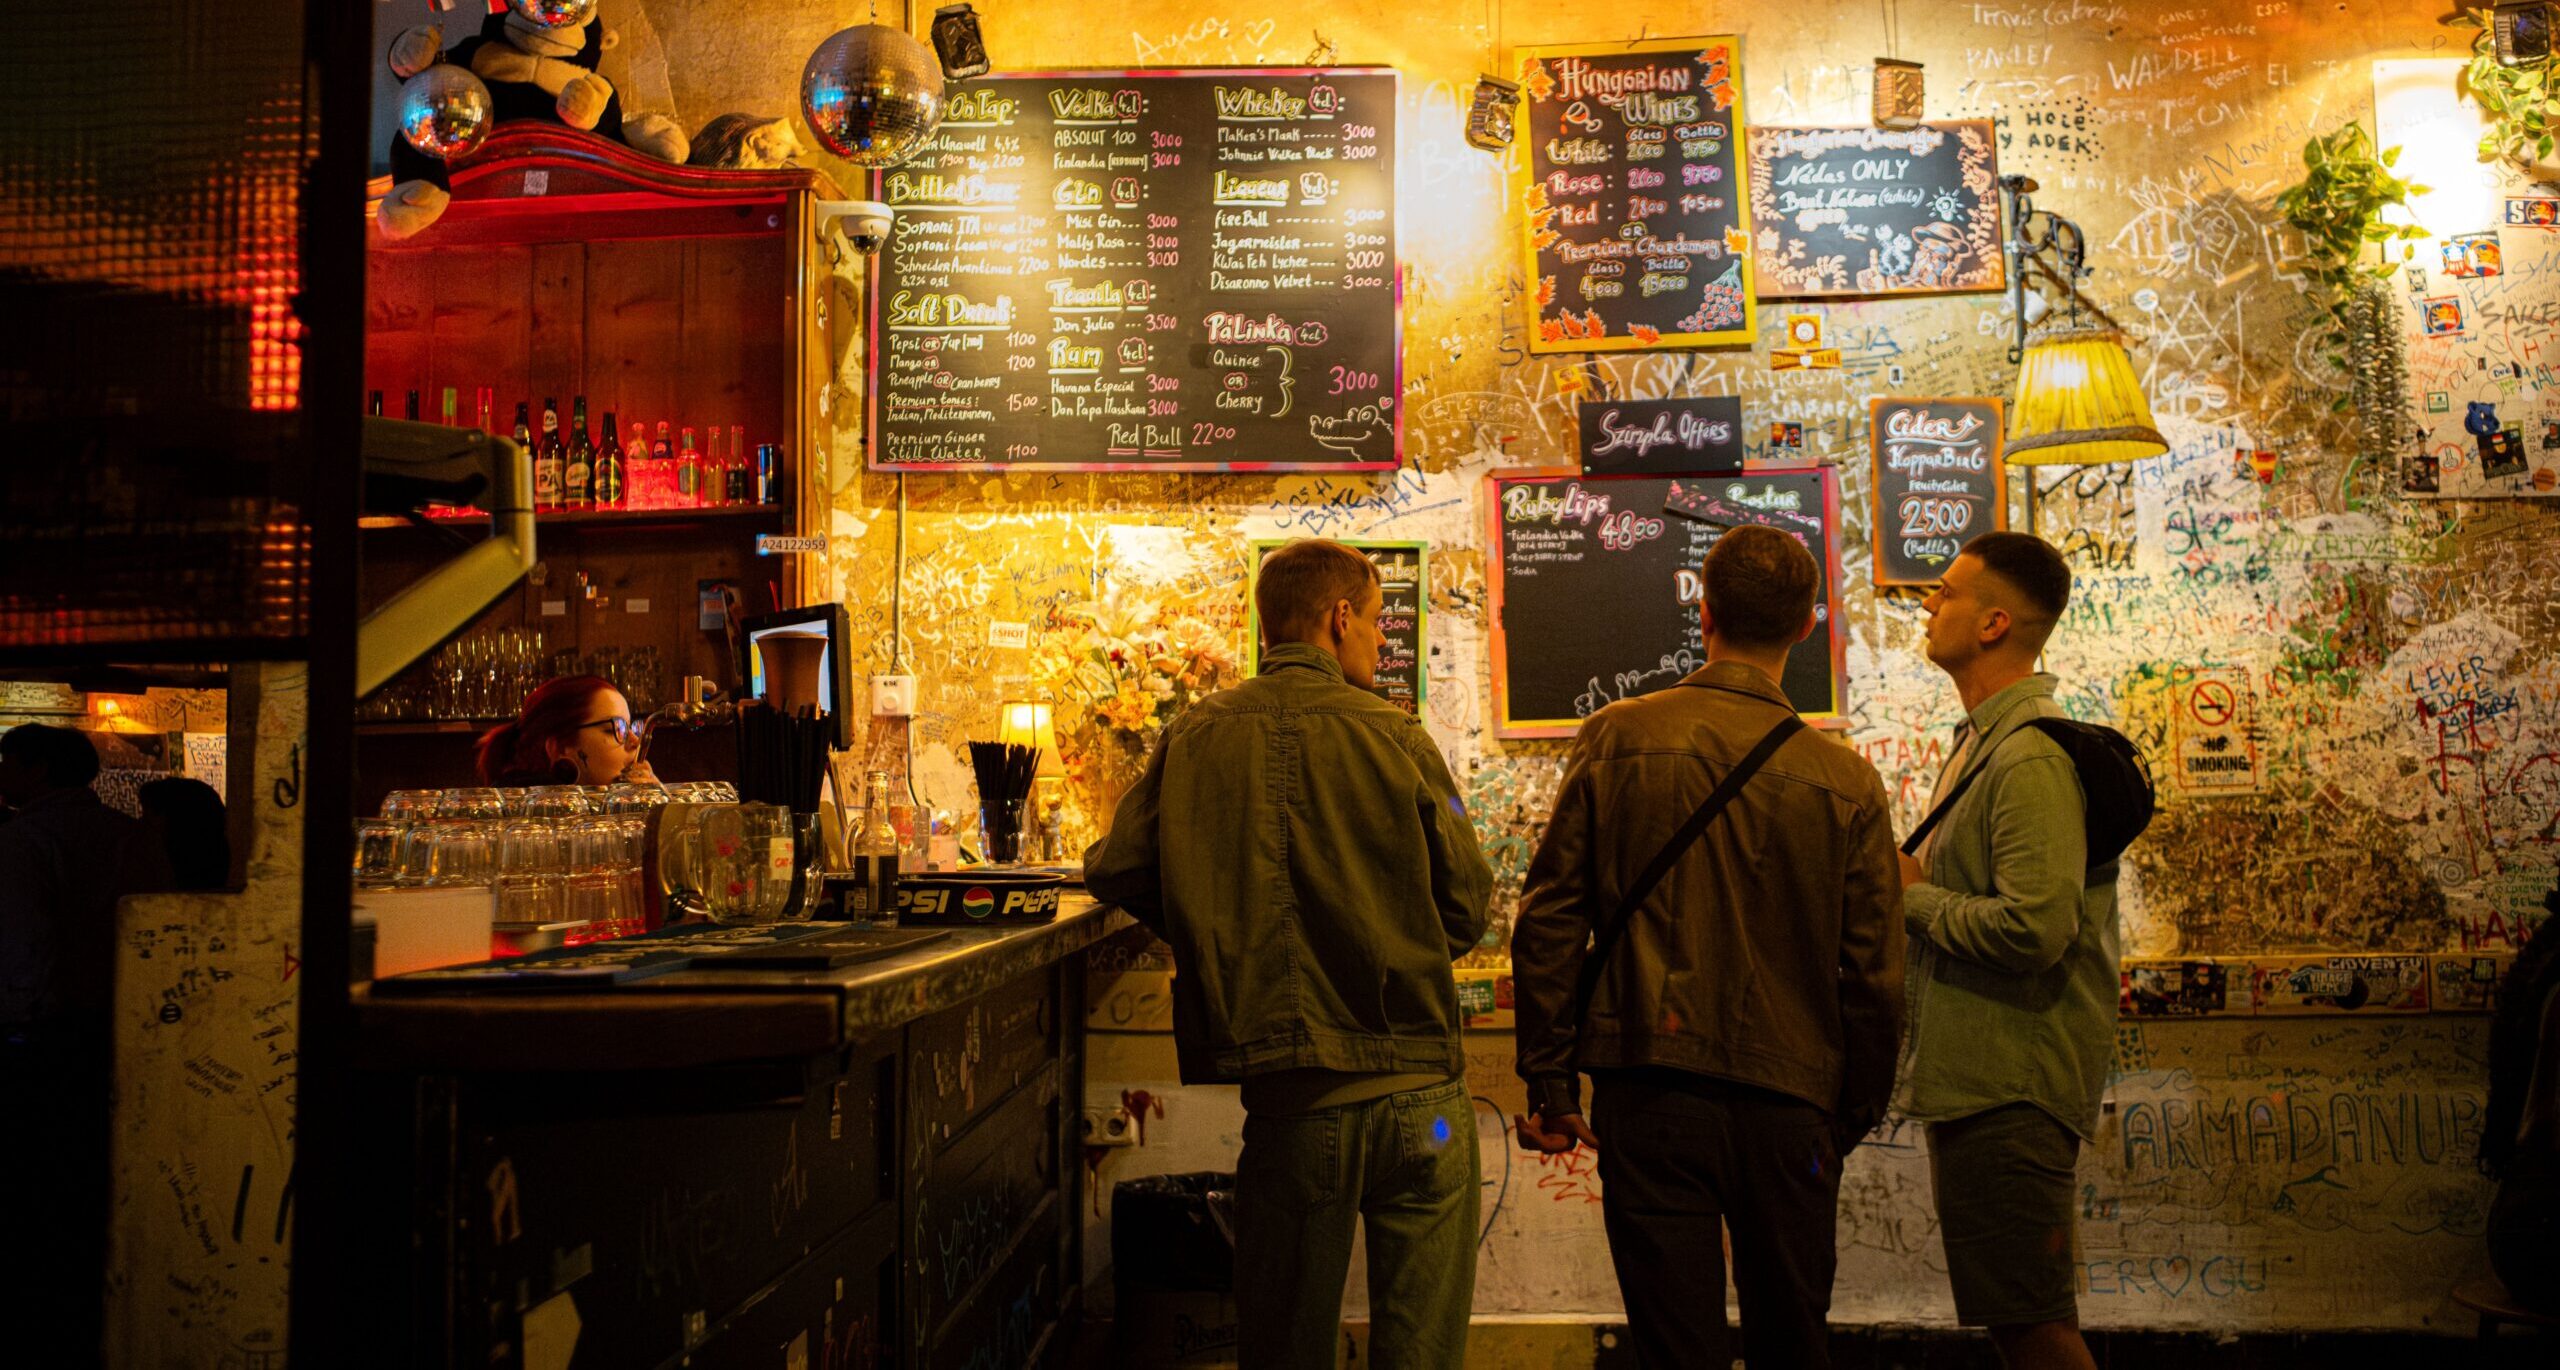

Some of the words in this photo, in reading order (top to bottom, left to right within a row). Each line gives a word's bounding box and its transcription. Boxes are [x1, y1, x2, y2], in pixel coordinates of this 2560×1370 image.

[1053, 129, 1107, 147] ABSOLUT
[1111, 130, 1137, 146] 100
[1150, 130, 1183, 149] 3000
[1341, 122, 1377, 142] 3000
[992, 155, 1025, 169] 2200
[1053, 151, 1106, 170] Finlandia
[1150, 152, 1182, 169] 3000
[1217, 147, 1265, 163] Johnnie
[1341, 145, 1378, 161] 3000
[1851, 158, 1911, 182] ONLY
[886, 172, 965, 205] Bottled
[1053, 176, 1102, 205] Gin
[1146, 212, 1178, 229] 3000
[1343, 207, 1387, 228] 3000
[1147, 233, 1179, 249] 3000
[1343, 231, 1387, 250] 3000
[1017, 256, 1050, 276] 2200
[1147, 251, 1180, 269] 3000
[1344, 250, 1386, 271] 3000
[1341, 273, 1384, 291] 3000
[888, 291, 941, 325] Soft
[1052, 316, 1081, 333] Don
[1081, 315, 1116, 335] Julio
[1144, 313, 1178, 333] 3500
[889, 333, 921, 353] Pepsi
[1005, 332, 1037, 348] 1100
[1046, 335, 1104, 368] Rum
[889, 354, 923, 372] Mango
[1006, 355, 1036, 372] 1200
[888, 373, 933, 391] Pineapple
[1050, 377, 1092, 394] Havana
[1094, 376, 1135, 397] Especial
[1145, 373, 1180, 394] 3000
[1327, 364, 1380, 396] 3000
[1006, 394, 1039, 413] 1500
[1051, 396, 1074, 419] Don
[1075, 395, 1103, 423] Papa
[1146, 398, 1179, 418] 3000
[1106, 422, 1140, 449] Red
[1142, 423, 1182, 448] Bull
[1191, 421, 1237, 447] 2200
[1590, 408, 1677, 458] Szimpla
[888, 446, 923, 461] Still
[1006, 444, 1039, 460] 1100
[1898, 495, 1974, 538] 2500
[1597, 509, 1665, 551] 4800
[761, 539, 826, 550] A24122959
[2407, 655, 2496, 693] LEVER
[2205, 735, 2229, 752] NO
[2187, 755, 2250, 772] SMOKING
